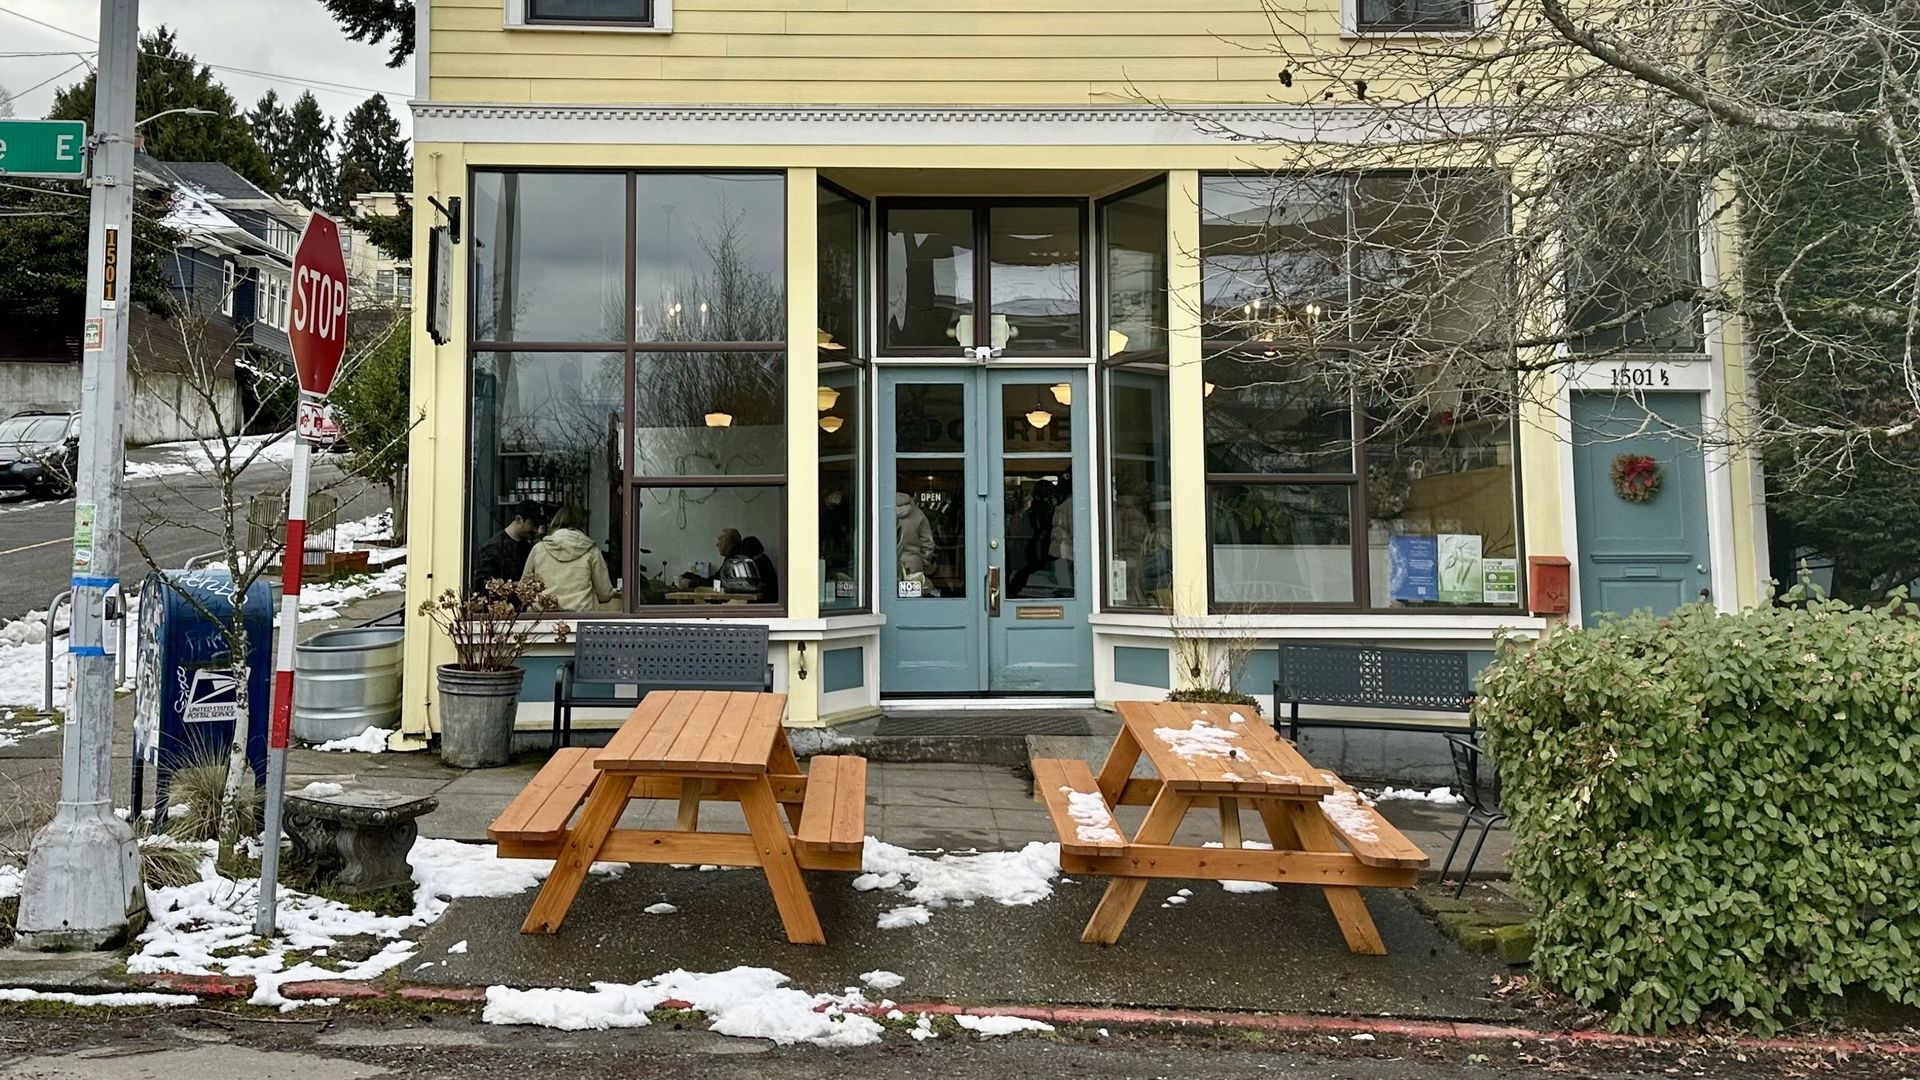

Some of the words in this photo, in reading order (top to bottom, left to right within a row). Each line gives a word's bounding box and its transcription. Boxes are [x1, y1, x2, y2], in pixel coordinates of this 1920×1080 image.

[56, 134, 74, 160] E
[104, 230, 116, 300] 1501
[294, 264, 345, 341] STOP
[1610, 368, 1654, 386] 1501
[920, 492, 942, 502] OPEN
[211, 710, 236, 718] SERVICE
